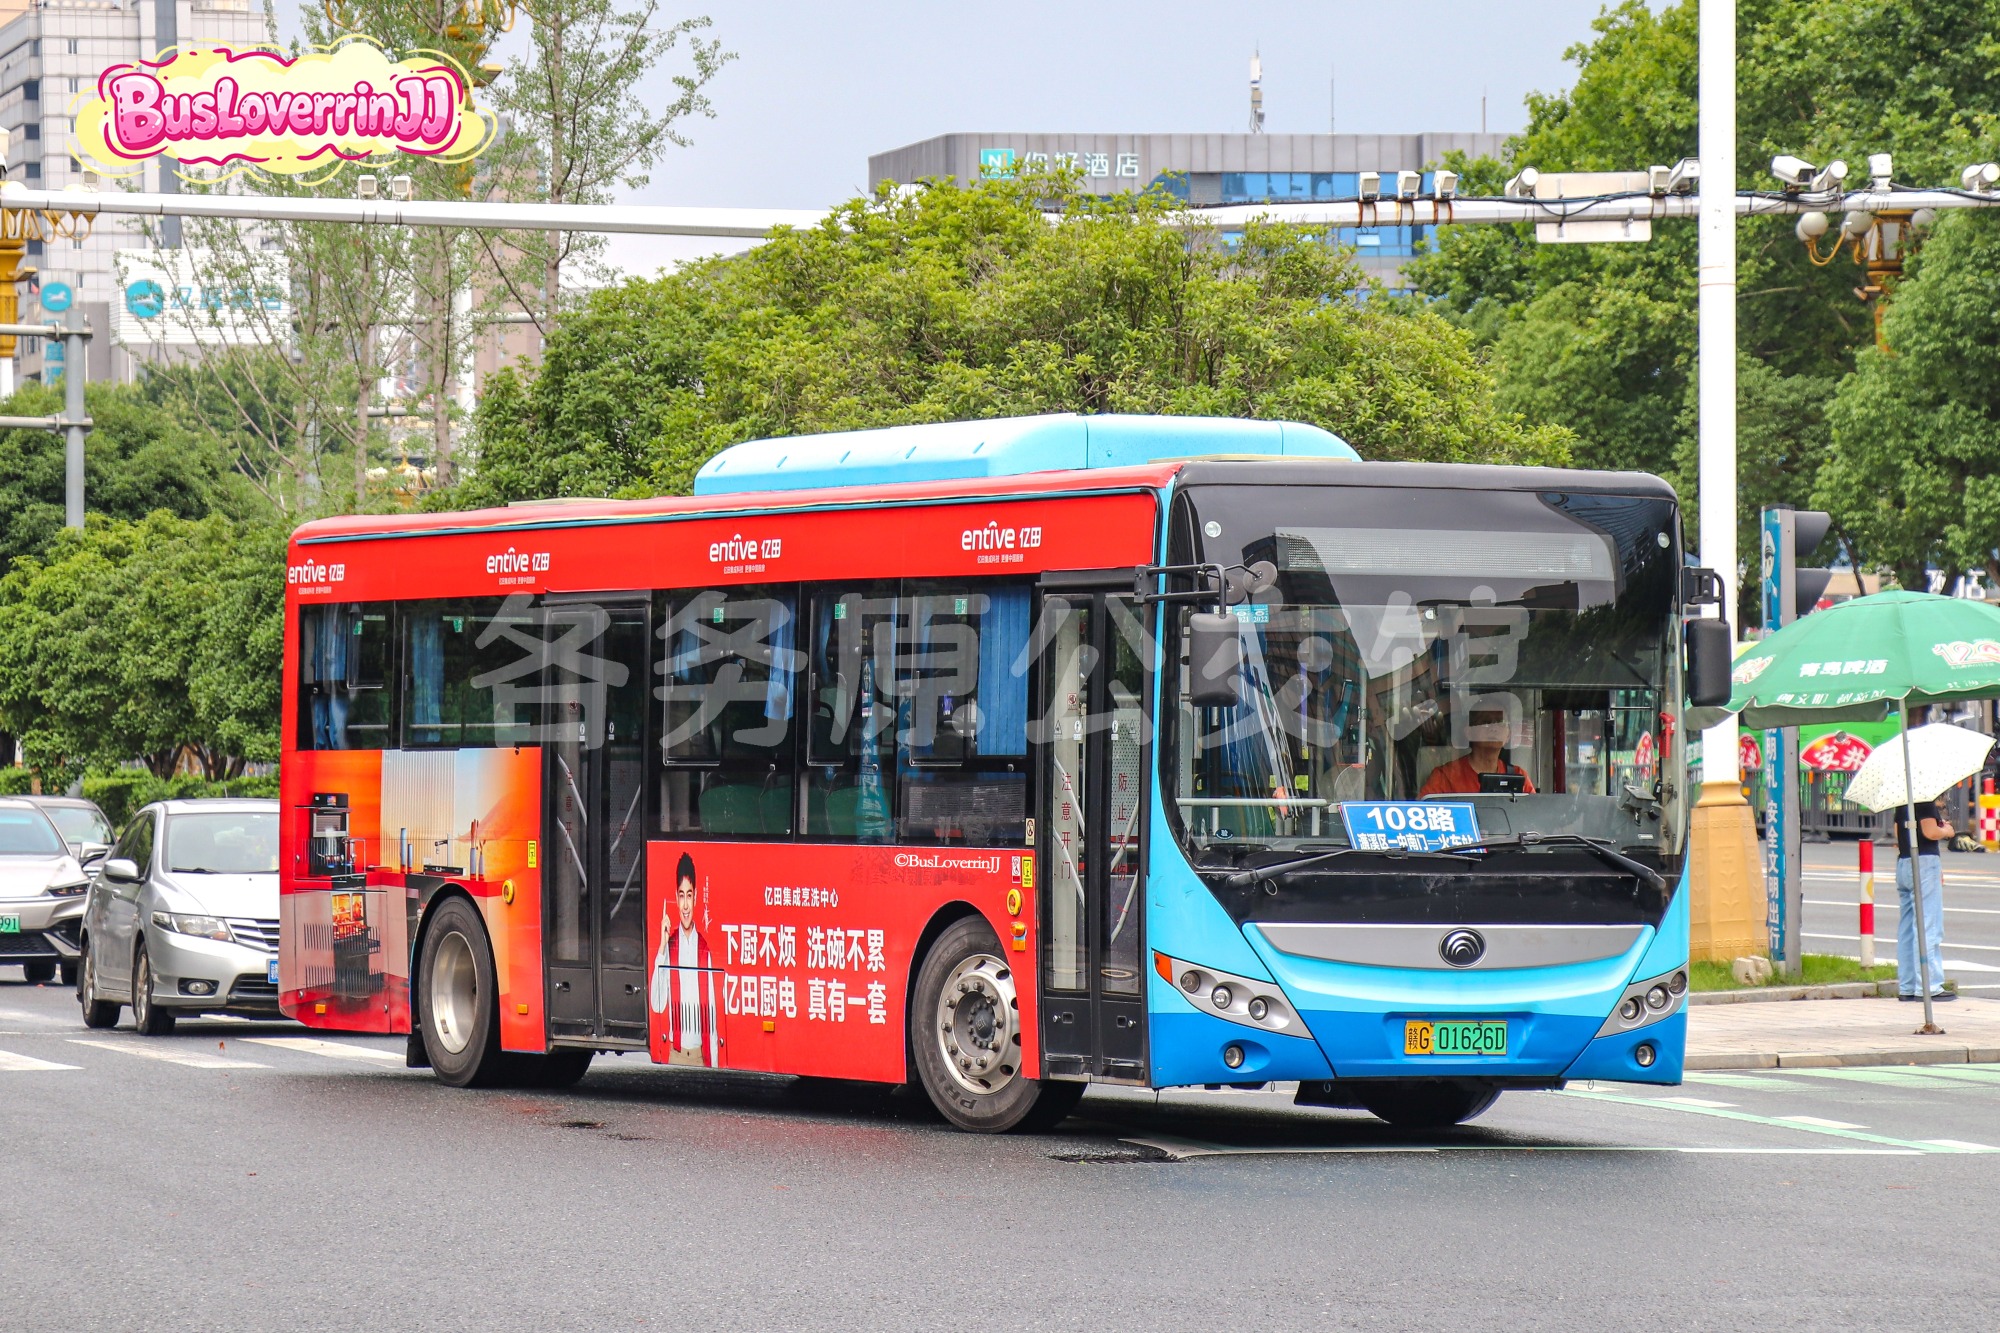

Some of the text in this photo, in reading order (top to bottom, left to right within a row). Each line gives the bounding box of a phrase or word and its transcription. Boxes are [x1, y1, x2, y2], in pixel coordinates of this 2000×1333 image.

[1024, 152, 1139, 177] 你好酒店
[709, 533, 781, 562] entive 亿田
[961, 520, 1041, 551] entive 亿田
[288, 558, 345, 584] entive 亿田
[486, 546, 550, 574] entive 亿田
[1799, 659, 1888, 678] 青岛啤酒
[1061, 772, 1072, 880] 注意开门
[1366, 806, 1456, 832] 108路
[1766, 800, 1781, 949] 安全文明出行
[764, 886, 839, 908] 亿田集成烹洗中心
[721, 924, 886, 972] 下厨不烦 洗碗不累
[723, 972, 887, 1025] 亿田厨电 真有一套
